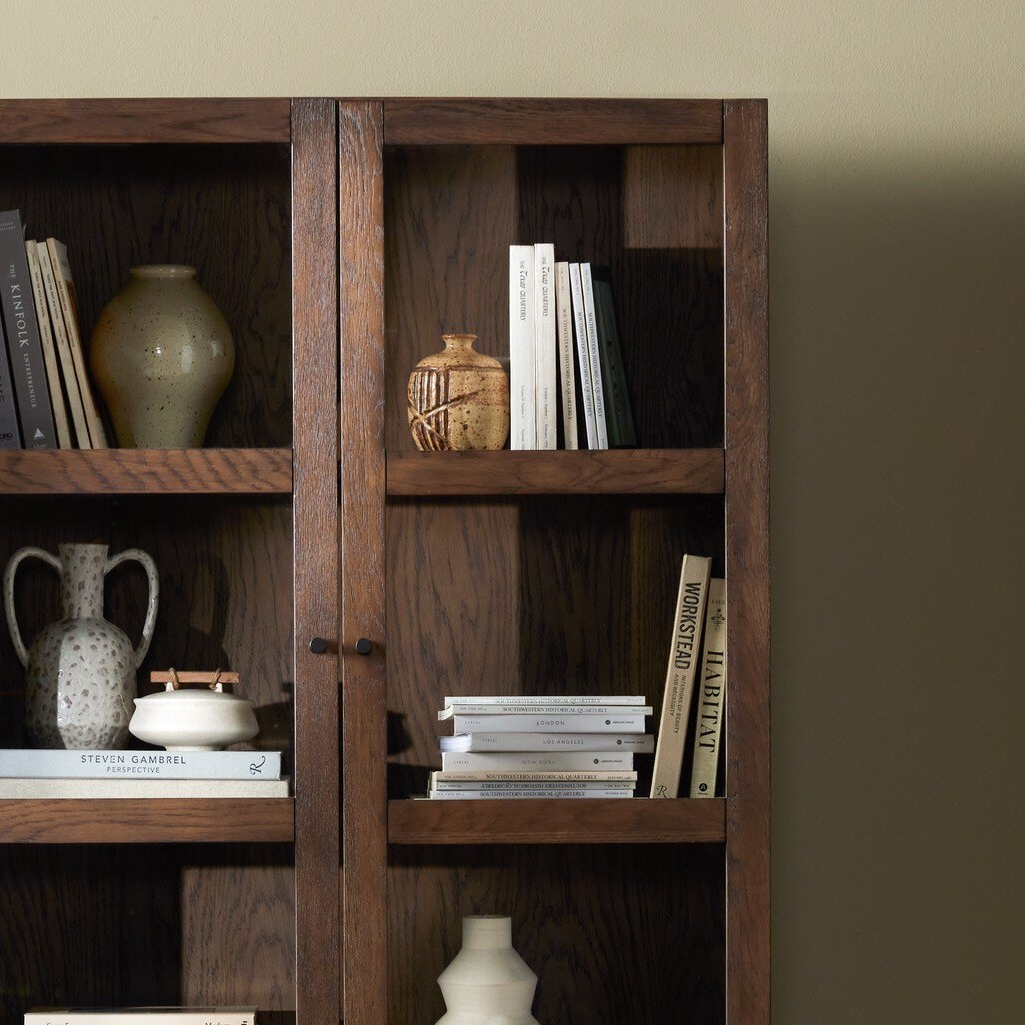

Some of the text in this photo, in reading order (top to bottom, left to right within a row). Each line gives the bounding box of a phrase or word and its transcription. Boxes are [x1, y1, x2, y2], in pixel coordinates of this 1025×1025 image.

[10, 284, 29, 348] KINFOLK
[23, 352, 37, 409] ENTREPRENEUR
[578, 311, 593, 417] SOUTHWESTERN HISTORICAL QUARTERLY
[588, 312, 603, 417] SOUTHWESTERN HISTORICAL QUARTERLY
[674, 582, 702, 670] WORKSTEAD
[698, 650, 724, 753] HABITAT
[81, 754, 186, 764] STEVEN GAMBREL
